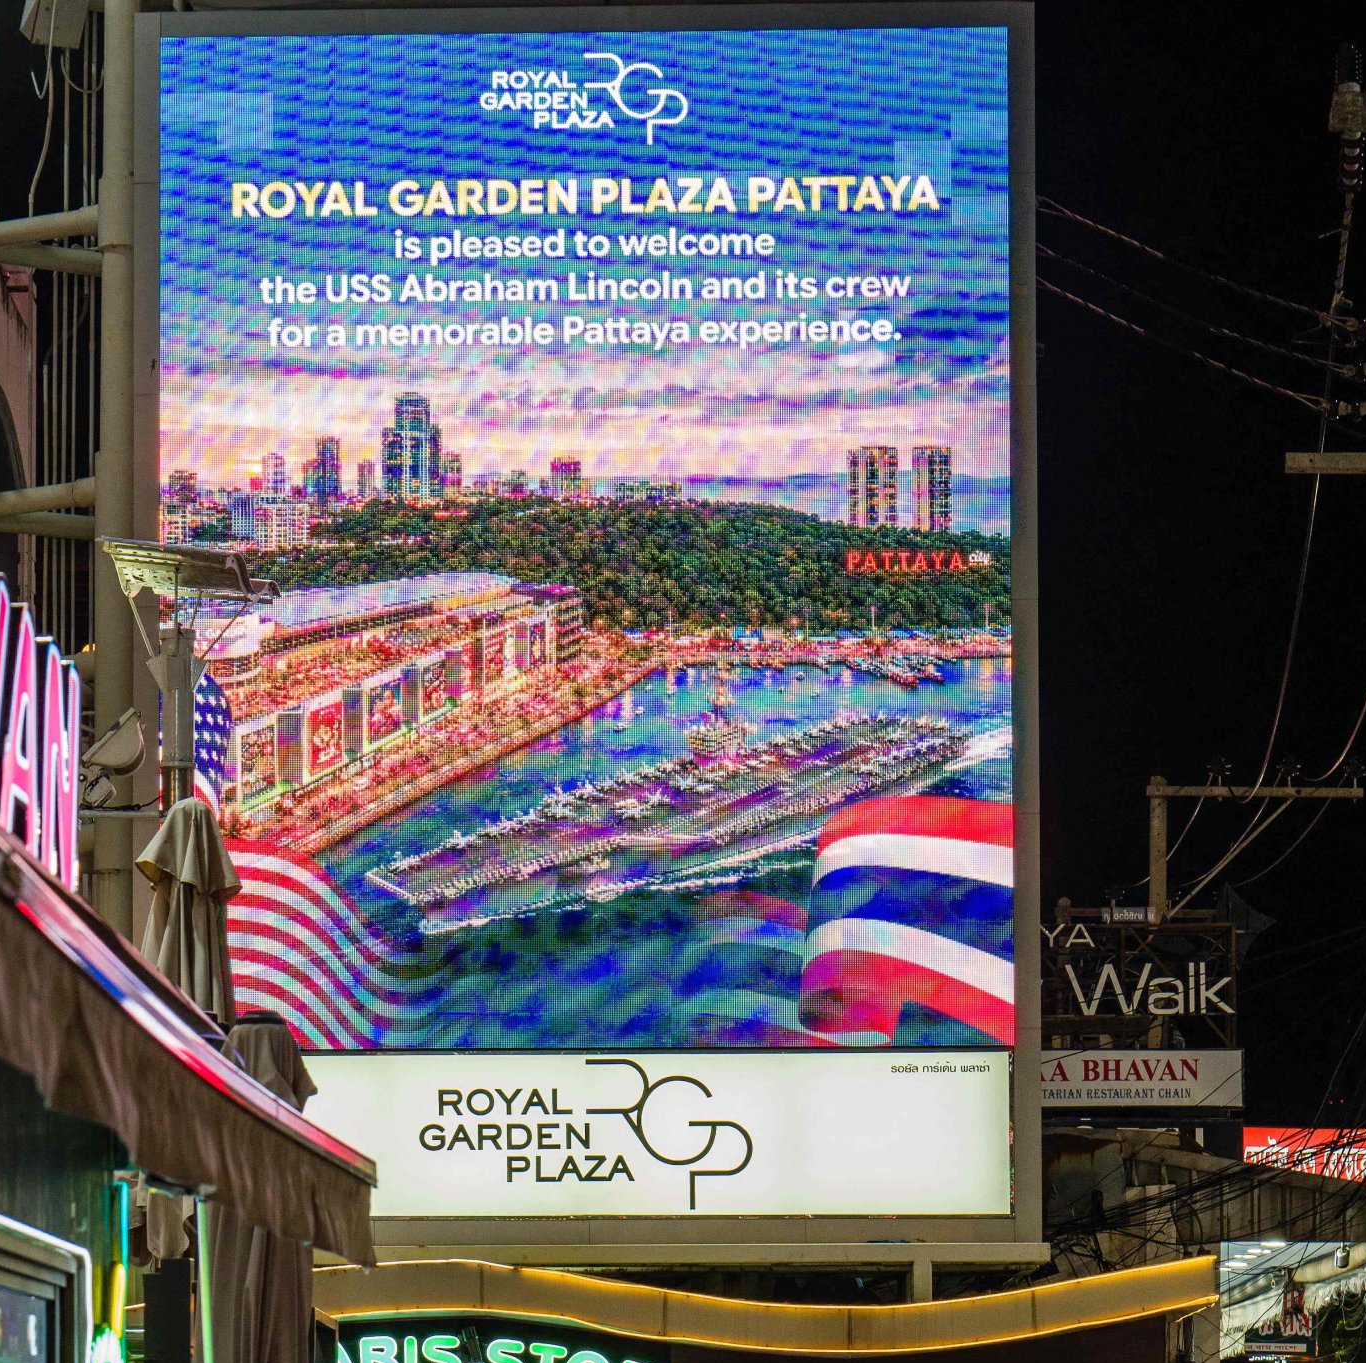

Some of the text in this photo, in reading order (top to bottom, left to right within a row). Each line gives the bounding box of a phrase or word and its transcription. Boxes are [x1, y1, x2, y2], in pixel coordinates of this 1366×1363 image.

[491, 71, 577, 89] ROYAL
[480, 91, 588, 109] GARDEN
[534, 110, 614, 129] PLAZA
[231, 176, 940, 219] ROYAL GARDEN PLAZA PATTAYA
[395, 229, 777, 266] is pleased to welcome
[260, 270, 912, 304] the USS Abraham Lincoln and its crew
[268, 315, 903, 350] for a memorable Pattaya experience.
[846, 550, 963, 572] PATTAYA
[1065, 962, 1236, 1016] Walk
[1040, 1059, 1200, 1082] A BHAVAN
[438, 1088, 572, 1116] ROYAL
[1086, 1088, 1156, 1099] RESTAURANT
[1158, 1088, 1192, 1099] CHAIN
[419, 1123, 591, 1151] GARDEN
[506, 1155, 635, 1182] PLAZA
